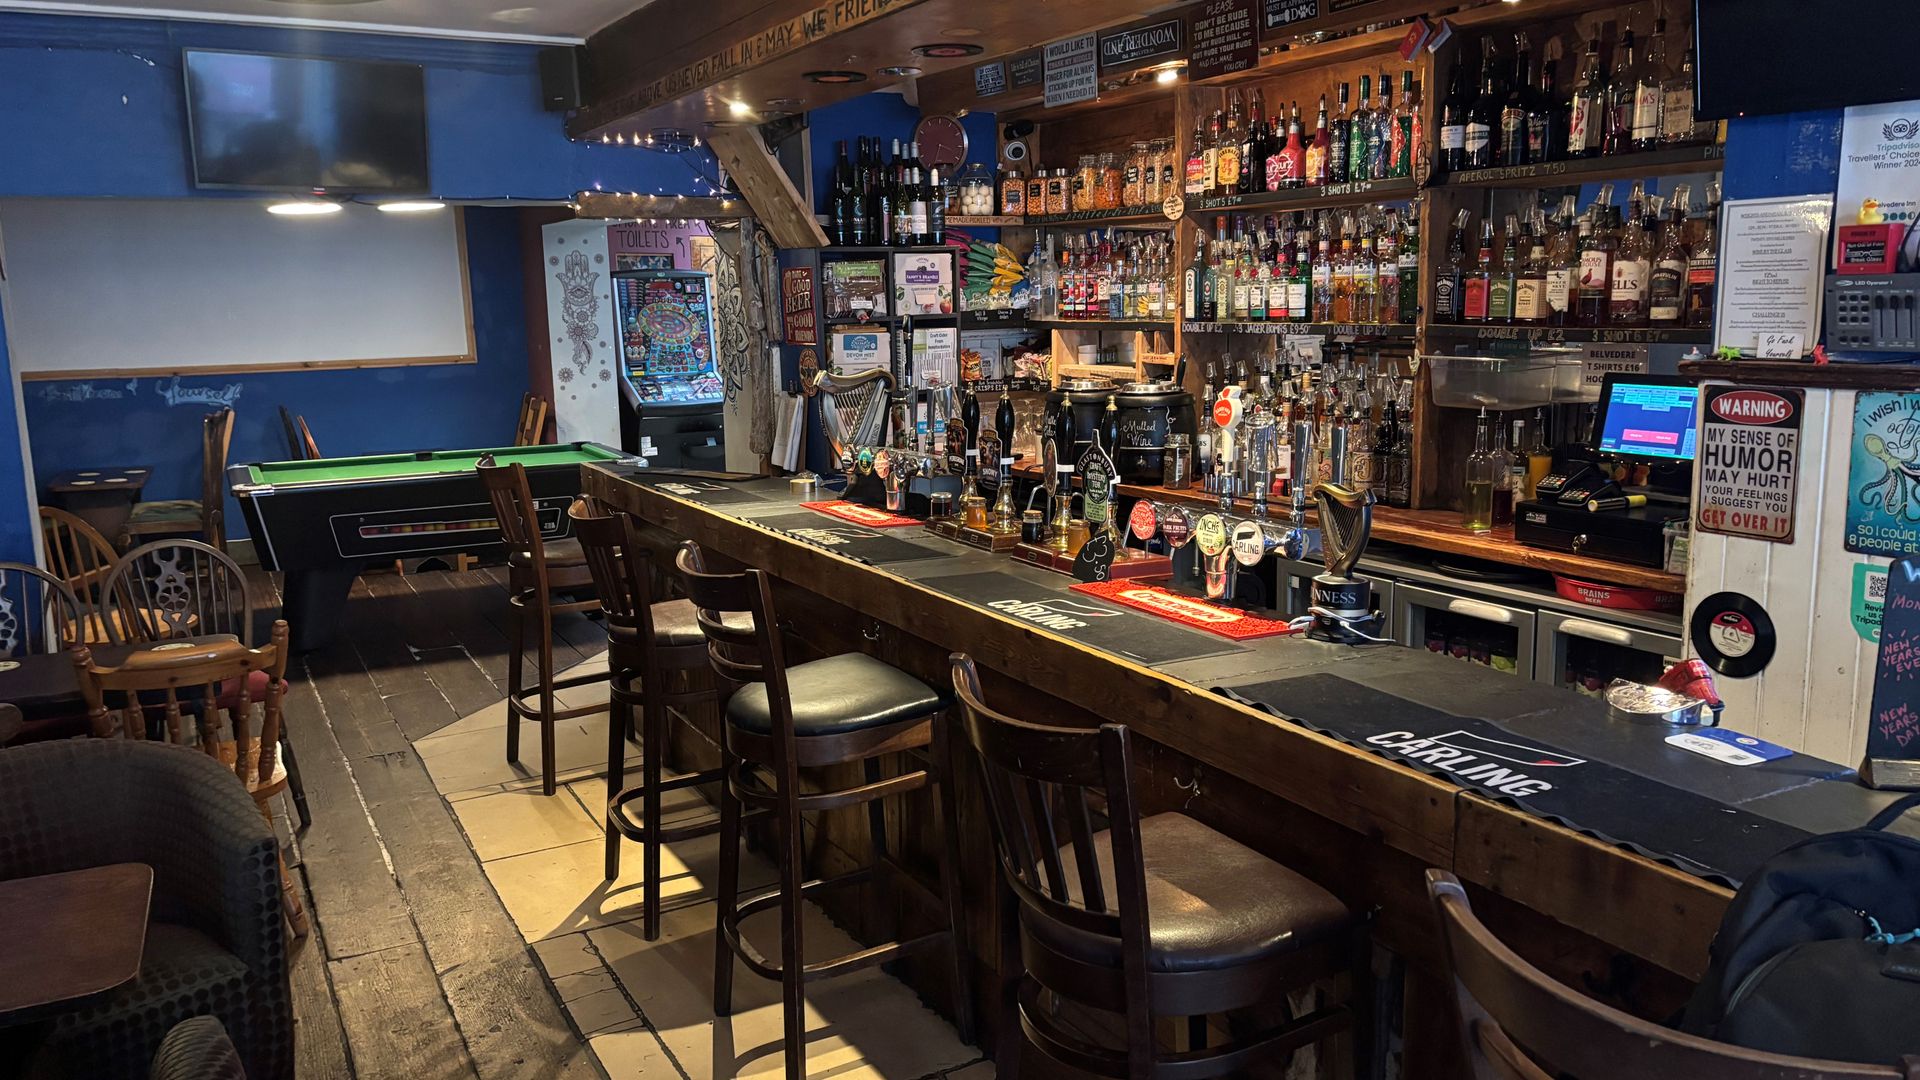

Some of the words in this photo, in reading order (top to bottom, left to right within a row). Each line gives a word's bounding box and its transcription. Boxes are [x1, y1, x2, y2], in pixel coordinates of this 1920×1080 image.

[1206, 0, 1236, 16] PLEASE
[1194, 18, 1216, 31] DON'T
[1216, 15, 1227, 25] BE
[1227, 8, 1249, 22] RUDE
[1193, 31, 1203, 42] TO
[1203, 28, 1215, 39] ME
[1215, 19, 1251, 36] BECAUSE
[1049, 42, 1069, 57] WOULD
[1070, 38, 1084, 51] LIKE
[1086, 36, 1094, 47] TO
[1104, 25, 1176, 56] WONDERLAND
[1219, 42, 1236, 53] YOUR
[680, 60, 709, 88] NEVER
[711, 48, 737, 76] FALL
[740, 40, 753, 65] IN
[765, 22, 795, 51] MAY
[803, 9, 829, 36] WE
[1063, 68, 1074, 80] FOR
[1074, 63, 1094, 77] ALWAYS
[1048, 82, 1068, 94] STICKING
[1066, 88, 1088, 100] NEEDED
[1877, 143, 1920, 153] Tripadviso
[1848, 152, 1888, 163] Travellers'
[1889, 151, 1920, 160] Choice
[1873, 160, 1902, 170] Winner
[1459, 171, 1493, 183] APEROL
[1499, 166, 1536, 180] SPRITZ
[1320, 186, 1326, 197] 3
[1328, 183, 1350, 196] SHOTS
[1206, 197, 1226, 208] SHOTS
[945, 216, 967, 224] MEMADE
[967, 216, 991, 224] PICKLED
[616, 230, 669, 249] TOILETS
[793, 279, 812, 293] GOOD
[1612, 279, 1638, 290] ELL'S
[786, 292, 812, 313] BEER
[795, 313, 814, 328] GOOD
[1182, 323, 1206, 333] DOUBLE
[1245, 324, 1265, 333] JAGER
[1333, 325, 1359, 335] DOUBLE
[1363, 325, 1373, 335] UP
[1478, 328, 1519, 338] DOUBLE
[1527, 329, 1542, 340] UP
[1592, 330, 1598, 341] 3
[1590, 350, 1636, 359] BELVEDERE
[1765, 348, 1793, 358] Yourself
[1593, 363, 1622, 371] SHIRTS
[1625, 363, 1640, 372] £16
[1718, 398, 1786, 418] WARNING
[1121, 420, 1156, 432] Mulled
[1863, 418, 1872, 427] I
[1127, 433, 1153, 446] Wine
[1707, 428, 1726, 443] MY
[1730, 429, 1771, 446] SENSE
[1777, 432, 1794, 449] OF
[1705, 444, 1792, 474] HUMOR
[1705, 468, 1740, 484] MAY
[1747, 472, 1791, 490] HURT
[1705, 485, 1733, 496] YOUR
[1737, 488, 1788, 502] FEELINGS
[1711, 496, 1760, 509] SUGGEST
[1765, 503, 1787, 513] YOU
[1702, 508, 1726, 526] GET
[1731, 512, 1768, 530] OVER
[1774, 516, 1787, 533] IT
[1857, 524, 1872, 536] so
[1881, 526, 1917, 541] could
[1232, 539, 1260, 555] CARLING
[1849, 534, 1856, 545] 8
[1859, 536, 1901, 551] people
[1904, 541, 1918, 553] at
[1312, 589, 1356, 604] INNESS
[1577, 587, 1610, 600] BRAINS
[987, 600, 1087, 631] CARLING
[1864, 604, 1884, 613] Revi
[1855, 615, 1883, 627] Tripad
[1884, 638, 1909, 655] NEW
[1882, 647, 1920, 667] YEARS
[1896, 659, 1920, 673] EVE
[1879, 703, 1907, 722] NEW
[1880, 713, 1918, 740] YEARS
[1896, 723, 1920, 747] DAY
[1366, 730, 1552, 797] CARLING
